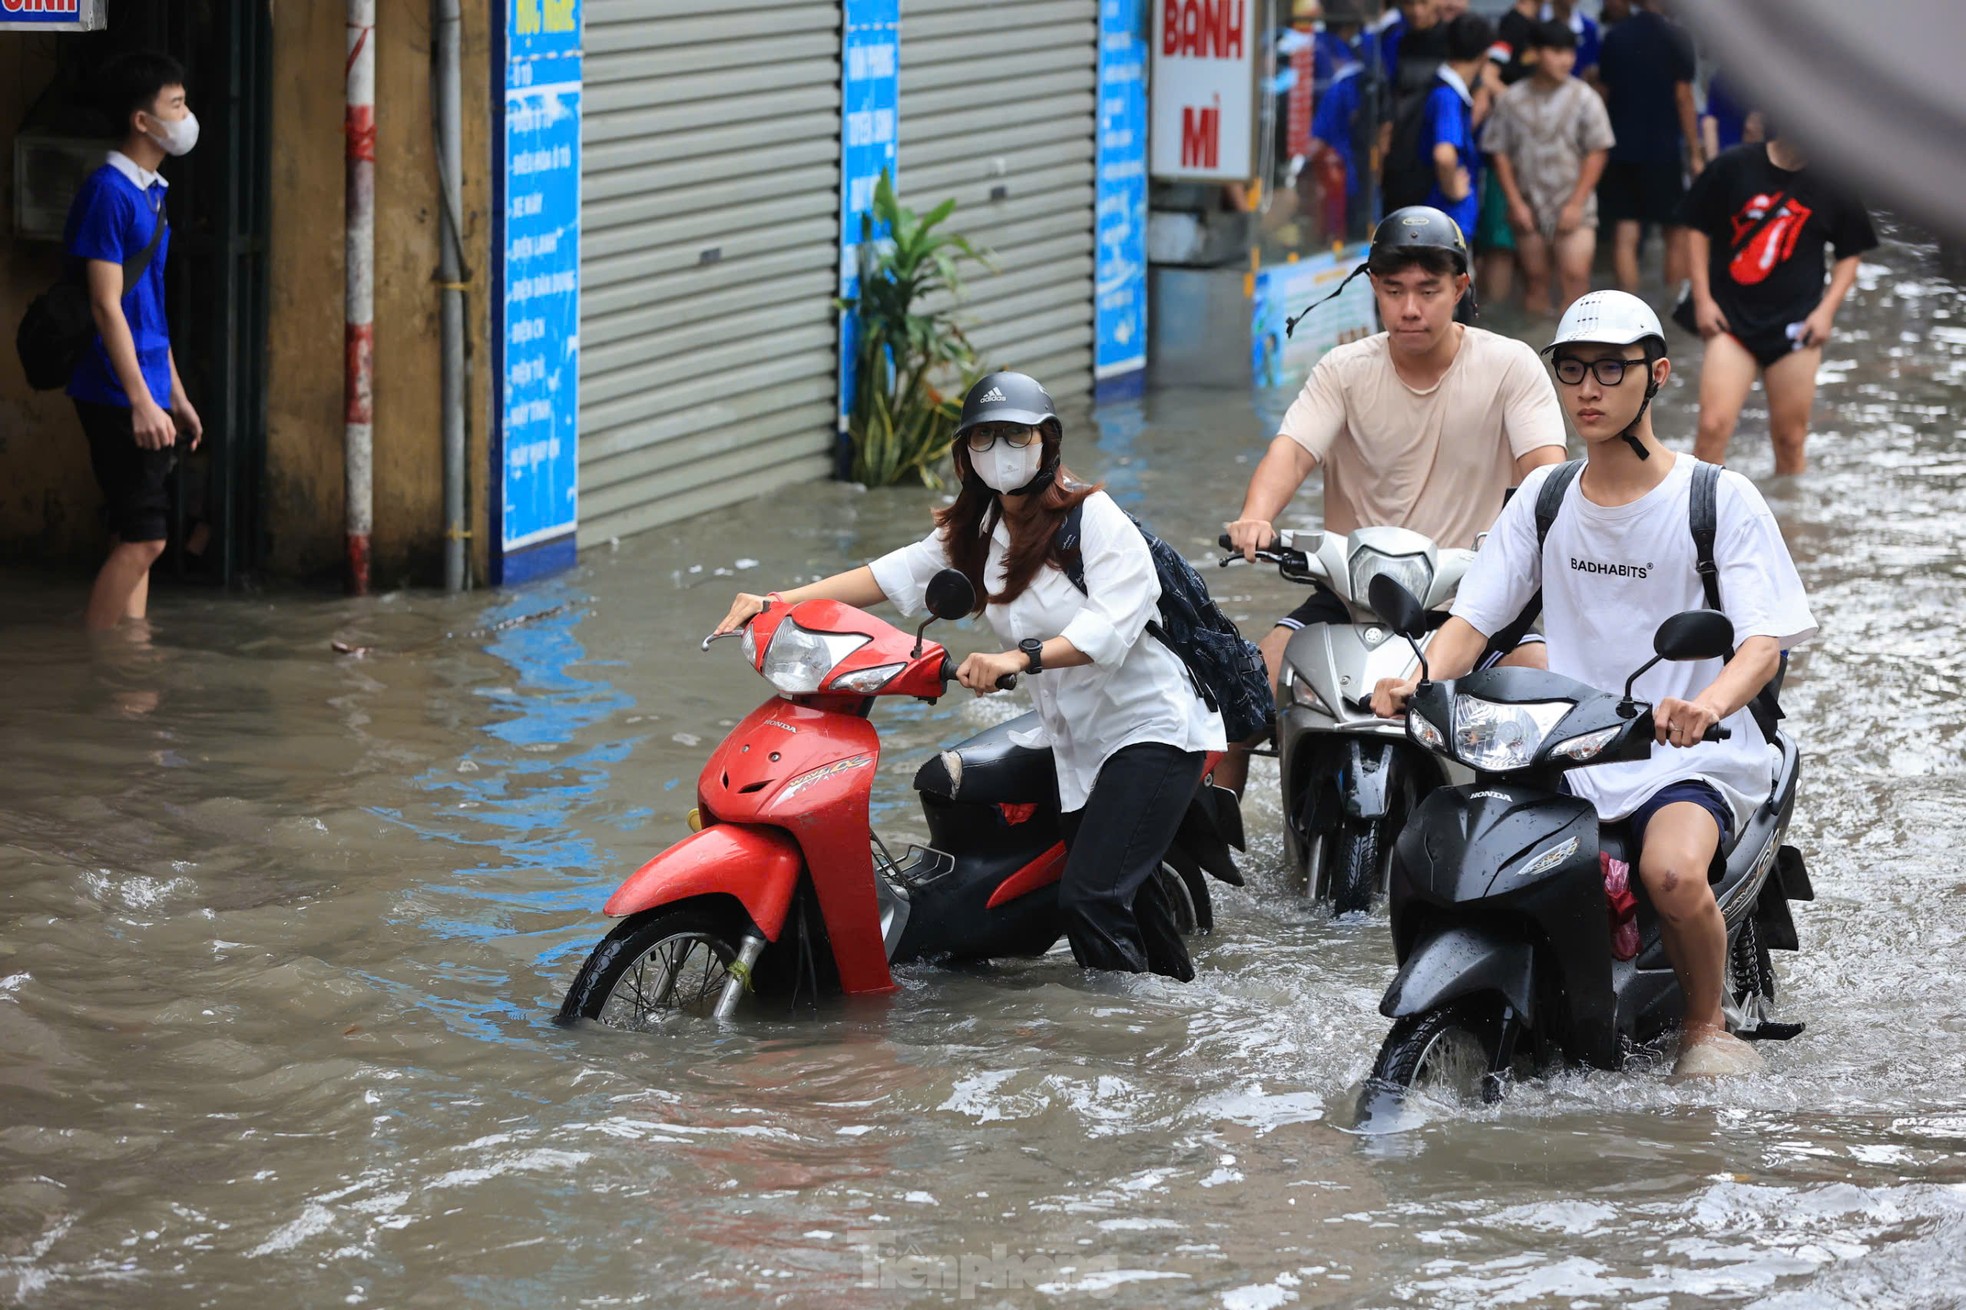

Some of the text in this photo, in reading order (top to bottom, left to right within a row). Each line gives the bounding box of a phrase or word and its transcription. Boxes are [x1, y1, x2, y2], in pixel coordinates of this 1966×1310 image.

[980, 395, 1007, 404] adidas
[764, 719, 797, 734] HONDA
[1470, 790, 1513, 802] HONDA
